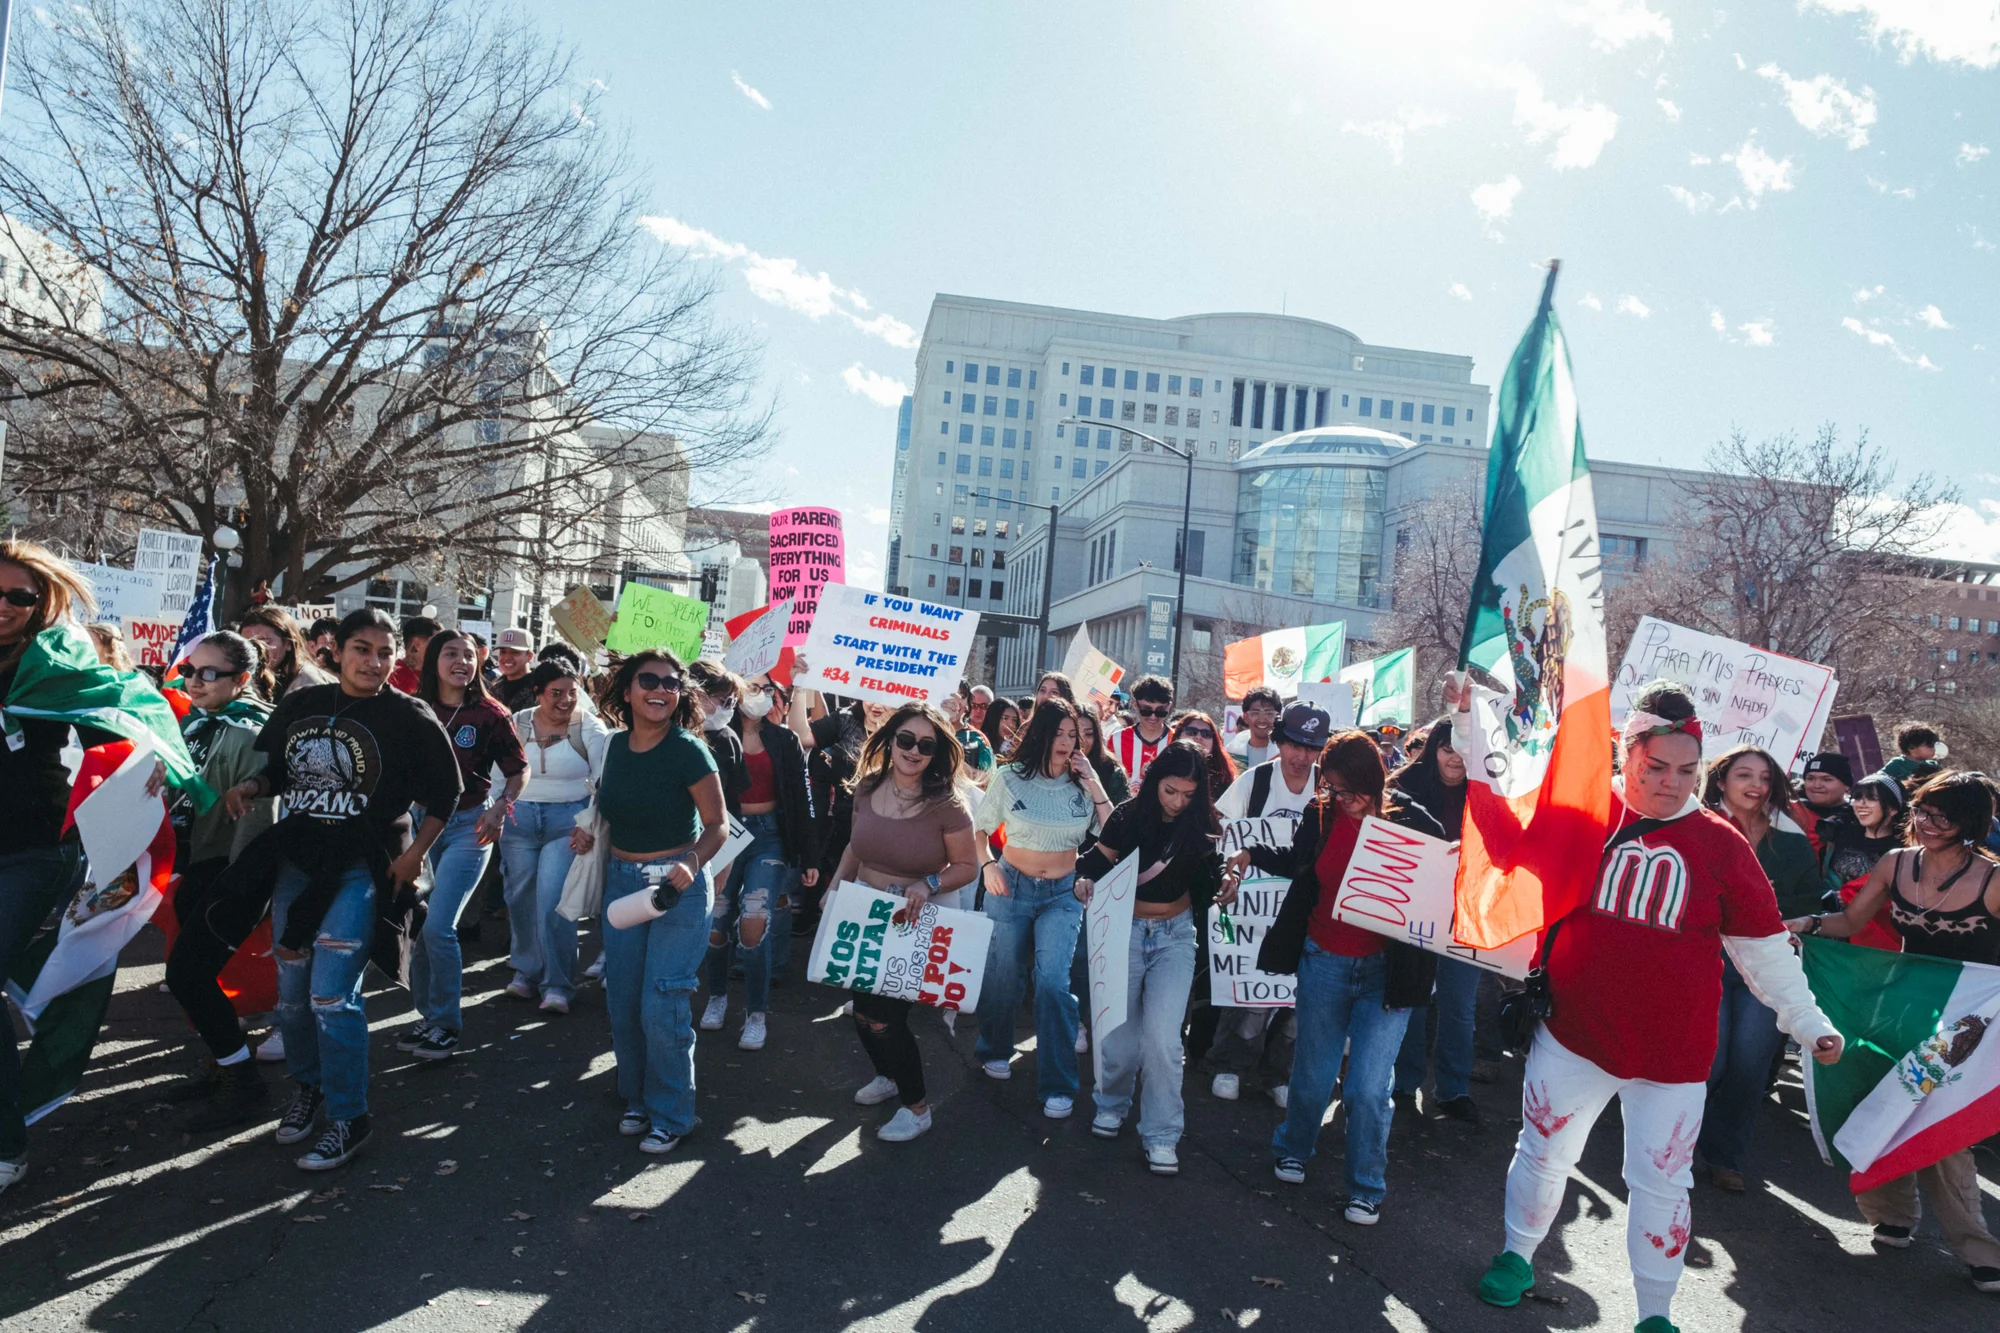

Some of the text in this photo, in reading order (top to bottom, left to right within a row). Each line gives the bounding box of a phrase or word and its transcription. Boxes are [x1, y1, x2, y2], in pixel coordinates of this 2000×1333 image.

[772, 512, 842, 531] OUR PARENTS
[139, 531, 165, 550] PROTECT
[770, 532, 838, 548] SACRIFICED
[136, 551, 191, 570] PROTECT WOMEN
[770, 551, 841, 568] EVERYTHING
[86, 566, 153, 587] Mexicans
[778, 568, 829, 583] FOR US
[772, 585, 796, 600] NOW
[301, 606, 334, 620] NOT
[632, 590, 654, 613] WE
[664, 600, 704, 627] SPEAK
[864, 594, 963, 622] IF YOU WANT
[1151, 600, 1170, 614] WILD
[632, 613, 662, 632] FOR
[788, 620, 812, 635] URN
[869, 616, 950, 641] CRIMINALS
[833, 634, 957, 666] START WITH THE
[1147, 654, 1165, 664] art
[1640, 623, 1804, 695] PARA MIS PADRES
[855, 655, 938, 677] PRESIDENT
[822, 667, 929, 700] #34 FELONIES
[1702, 687, 1721, 704] SIN
[1731, 696, 1768, 718] NADA
[346, 736, 366, 773] PROUD
[283, 789, 368, 815] HICANO
[1216, 818, 1276, 853] ARA
[1340, 824, 1425, 926] DOWN
[915, 903, 939, 949] MIOS
[1211, 921, 1254, 944] SN
[924, 925, 954, 986] POR
[1213, 953, 1251, 976] ME
[905, 950, 927, 992] LOS
